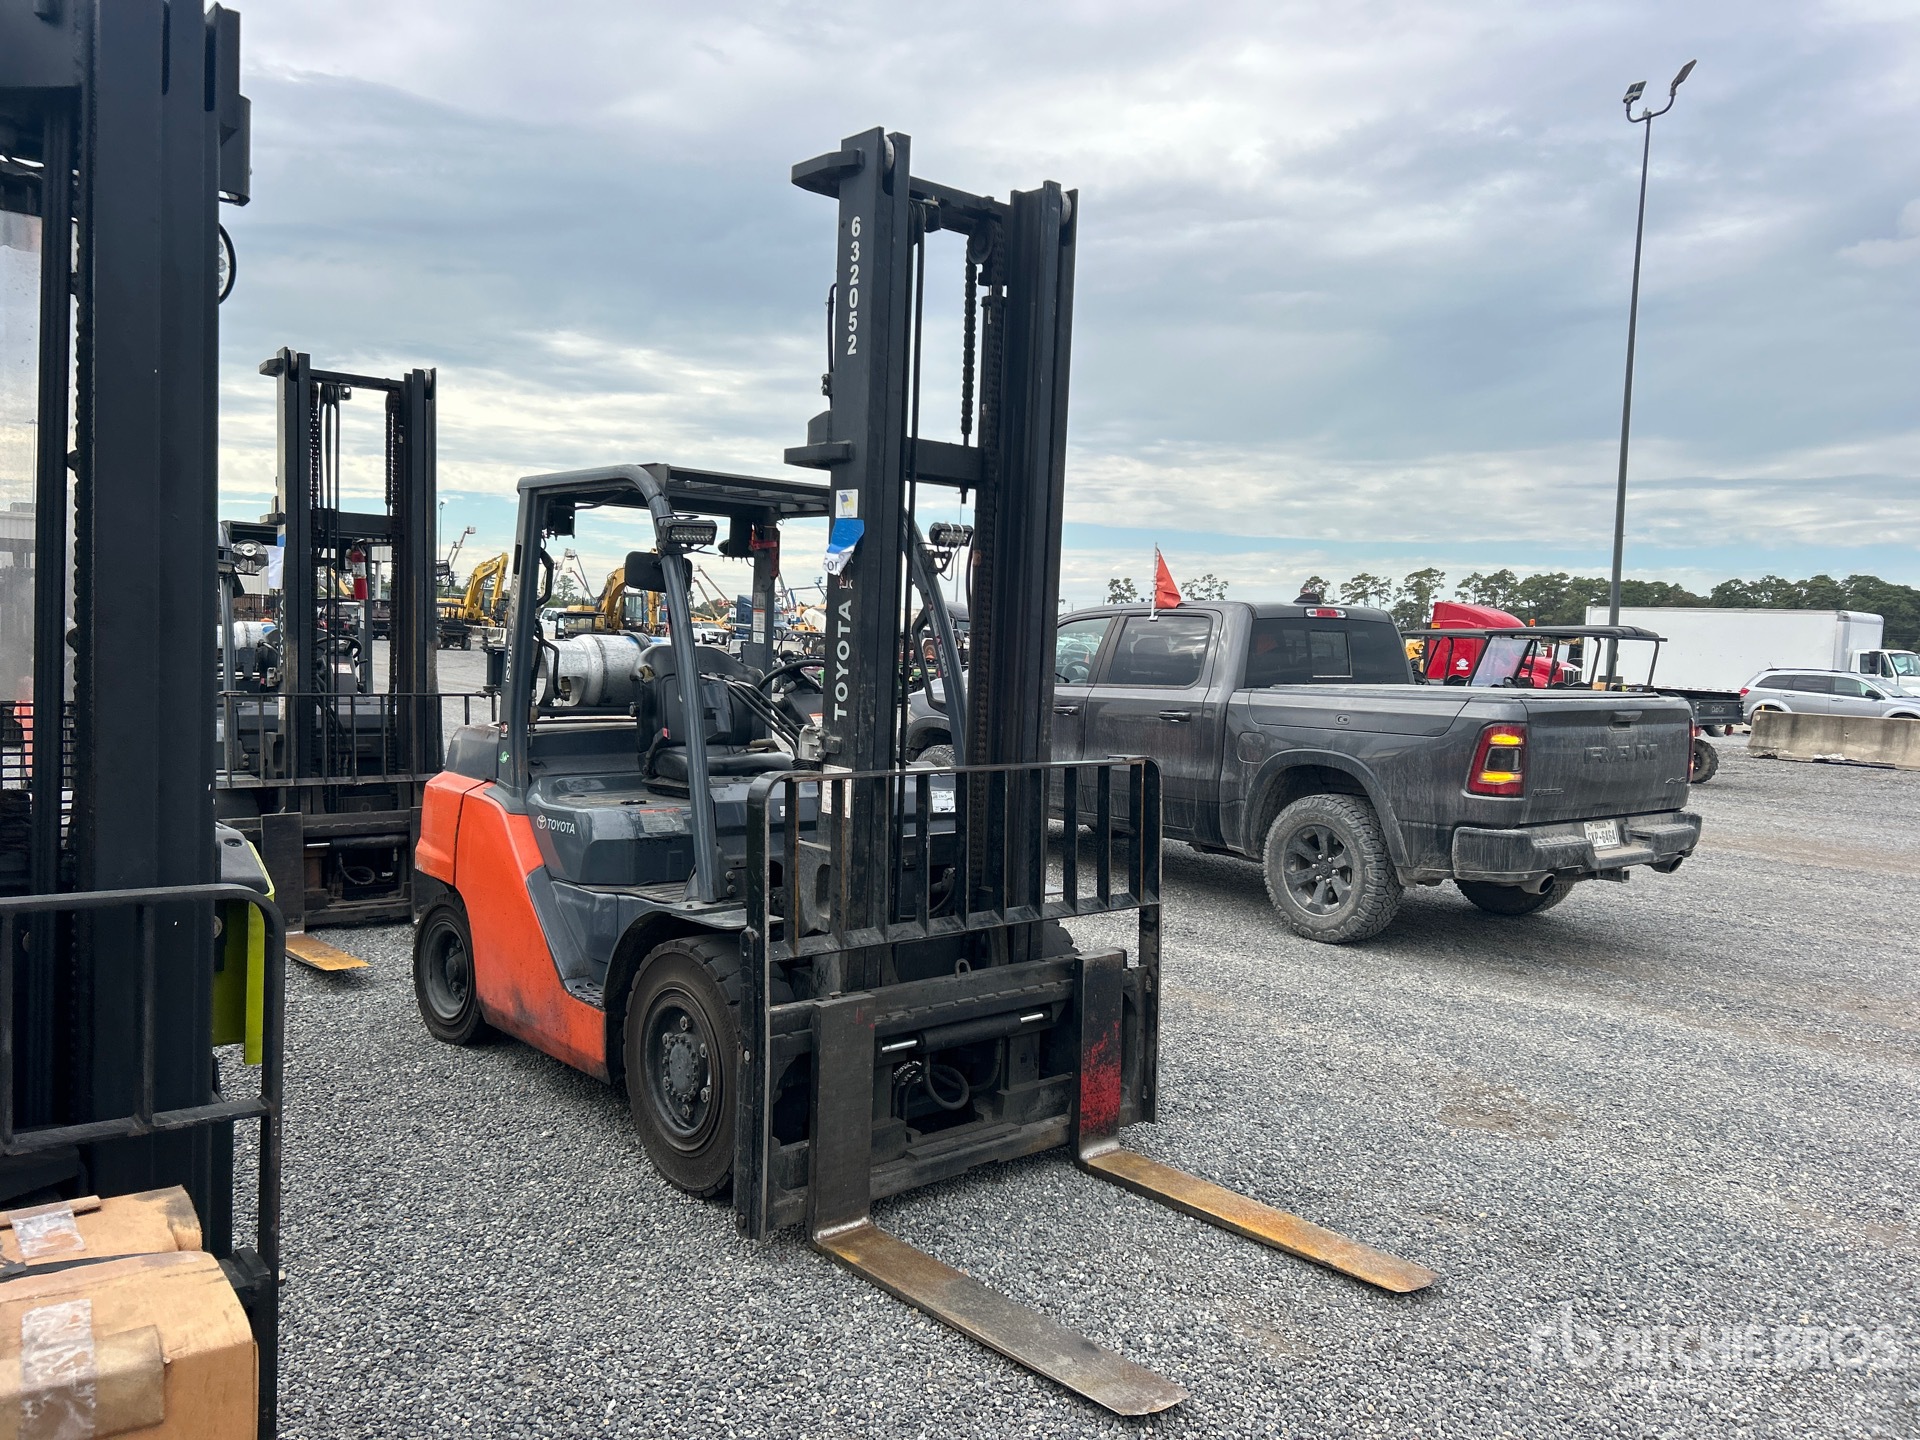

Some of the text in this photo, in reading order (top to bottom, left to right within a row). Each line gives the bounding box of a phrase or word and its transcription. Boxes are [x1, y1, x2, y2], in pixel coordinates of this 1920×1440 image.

[847, 216, 861, 355] 632052
[834, 599, 852, 721] TOYOTA
[1583, 743, 1659, 765] RAM
[546, 817, 576, 835] TOYOTA
